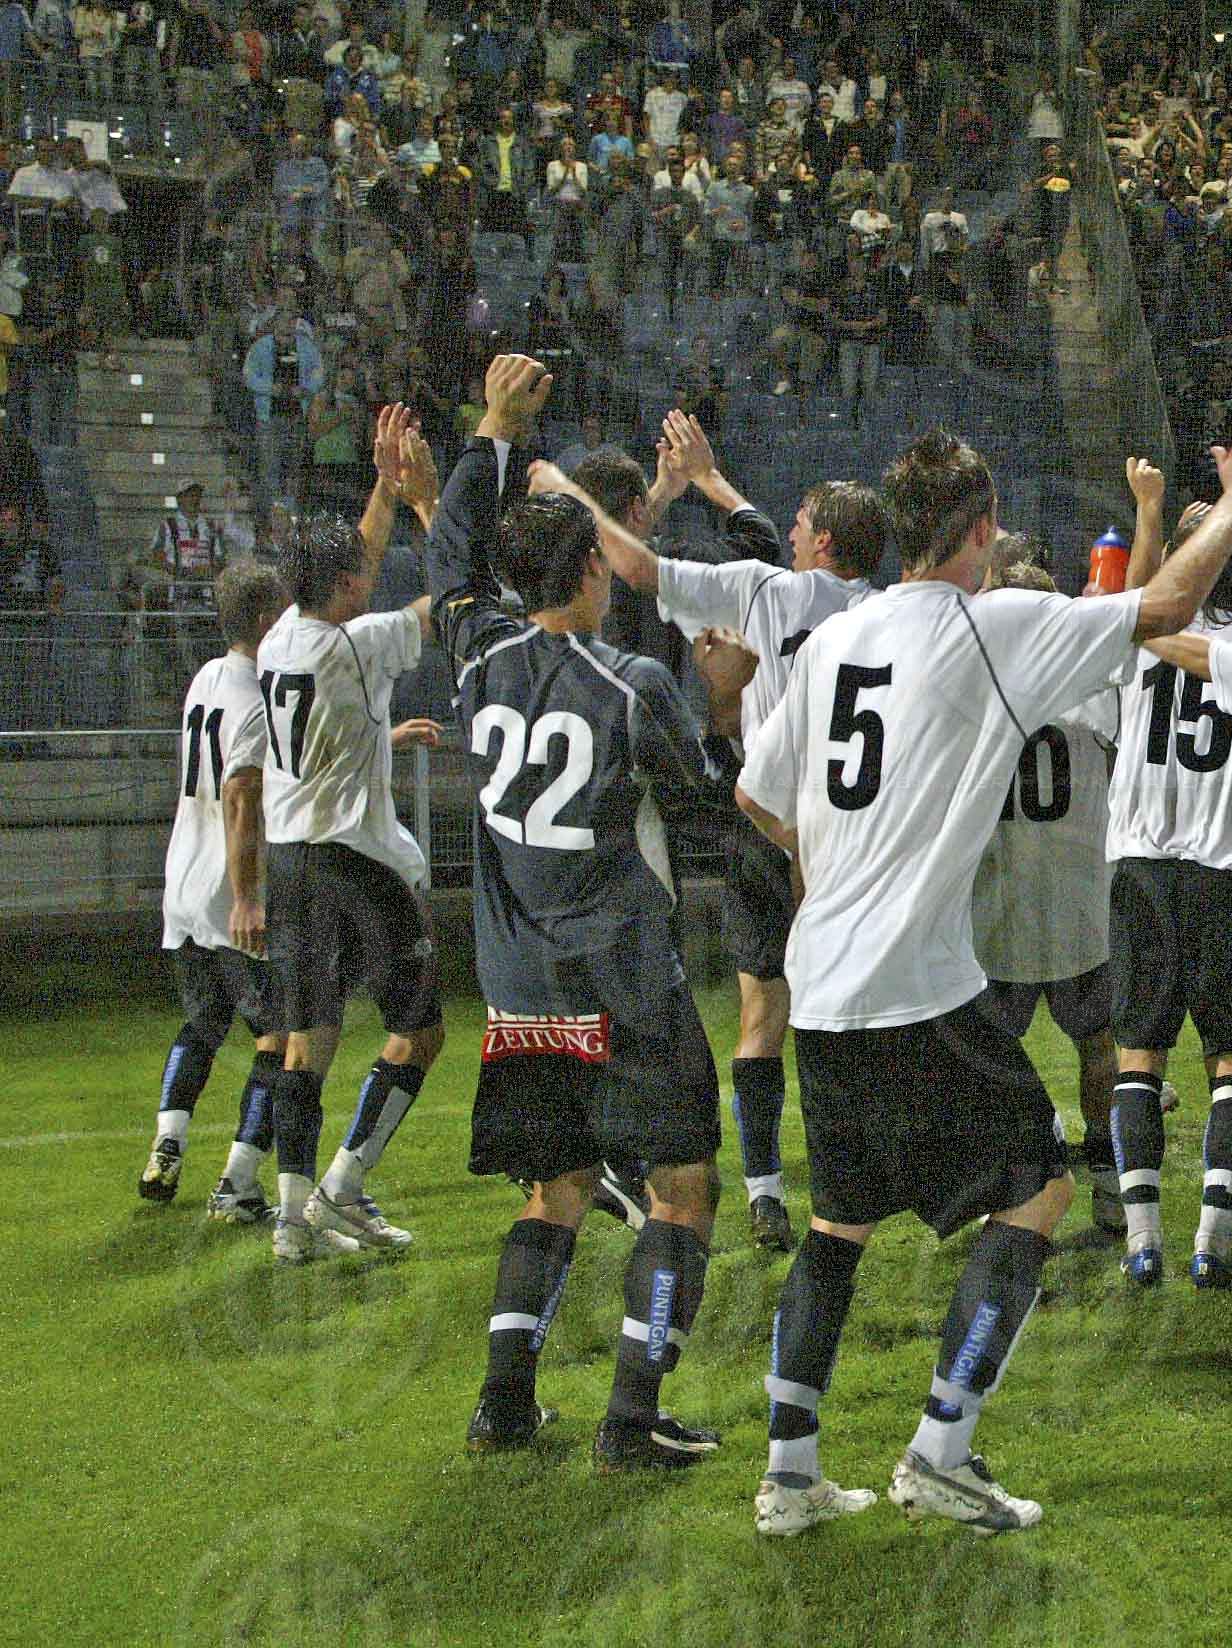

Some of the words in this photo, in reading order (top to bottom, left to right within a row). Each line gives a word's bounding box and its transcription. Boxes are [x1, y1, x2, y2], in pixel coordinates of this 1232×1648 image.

[185, 704, 225, 801] 11
[259, 669, 316, 779] 17
[471, 703, 596, 851] 22
[826, 662, 893, 811] 5
[486, 1029, 605, 1055] ZEITUNG
